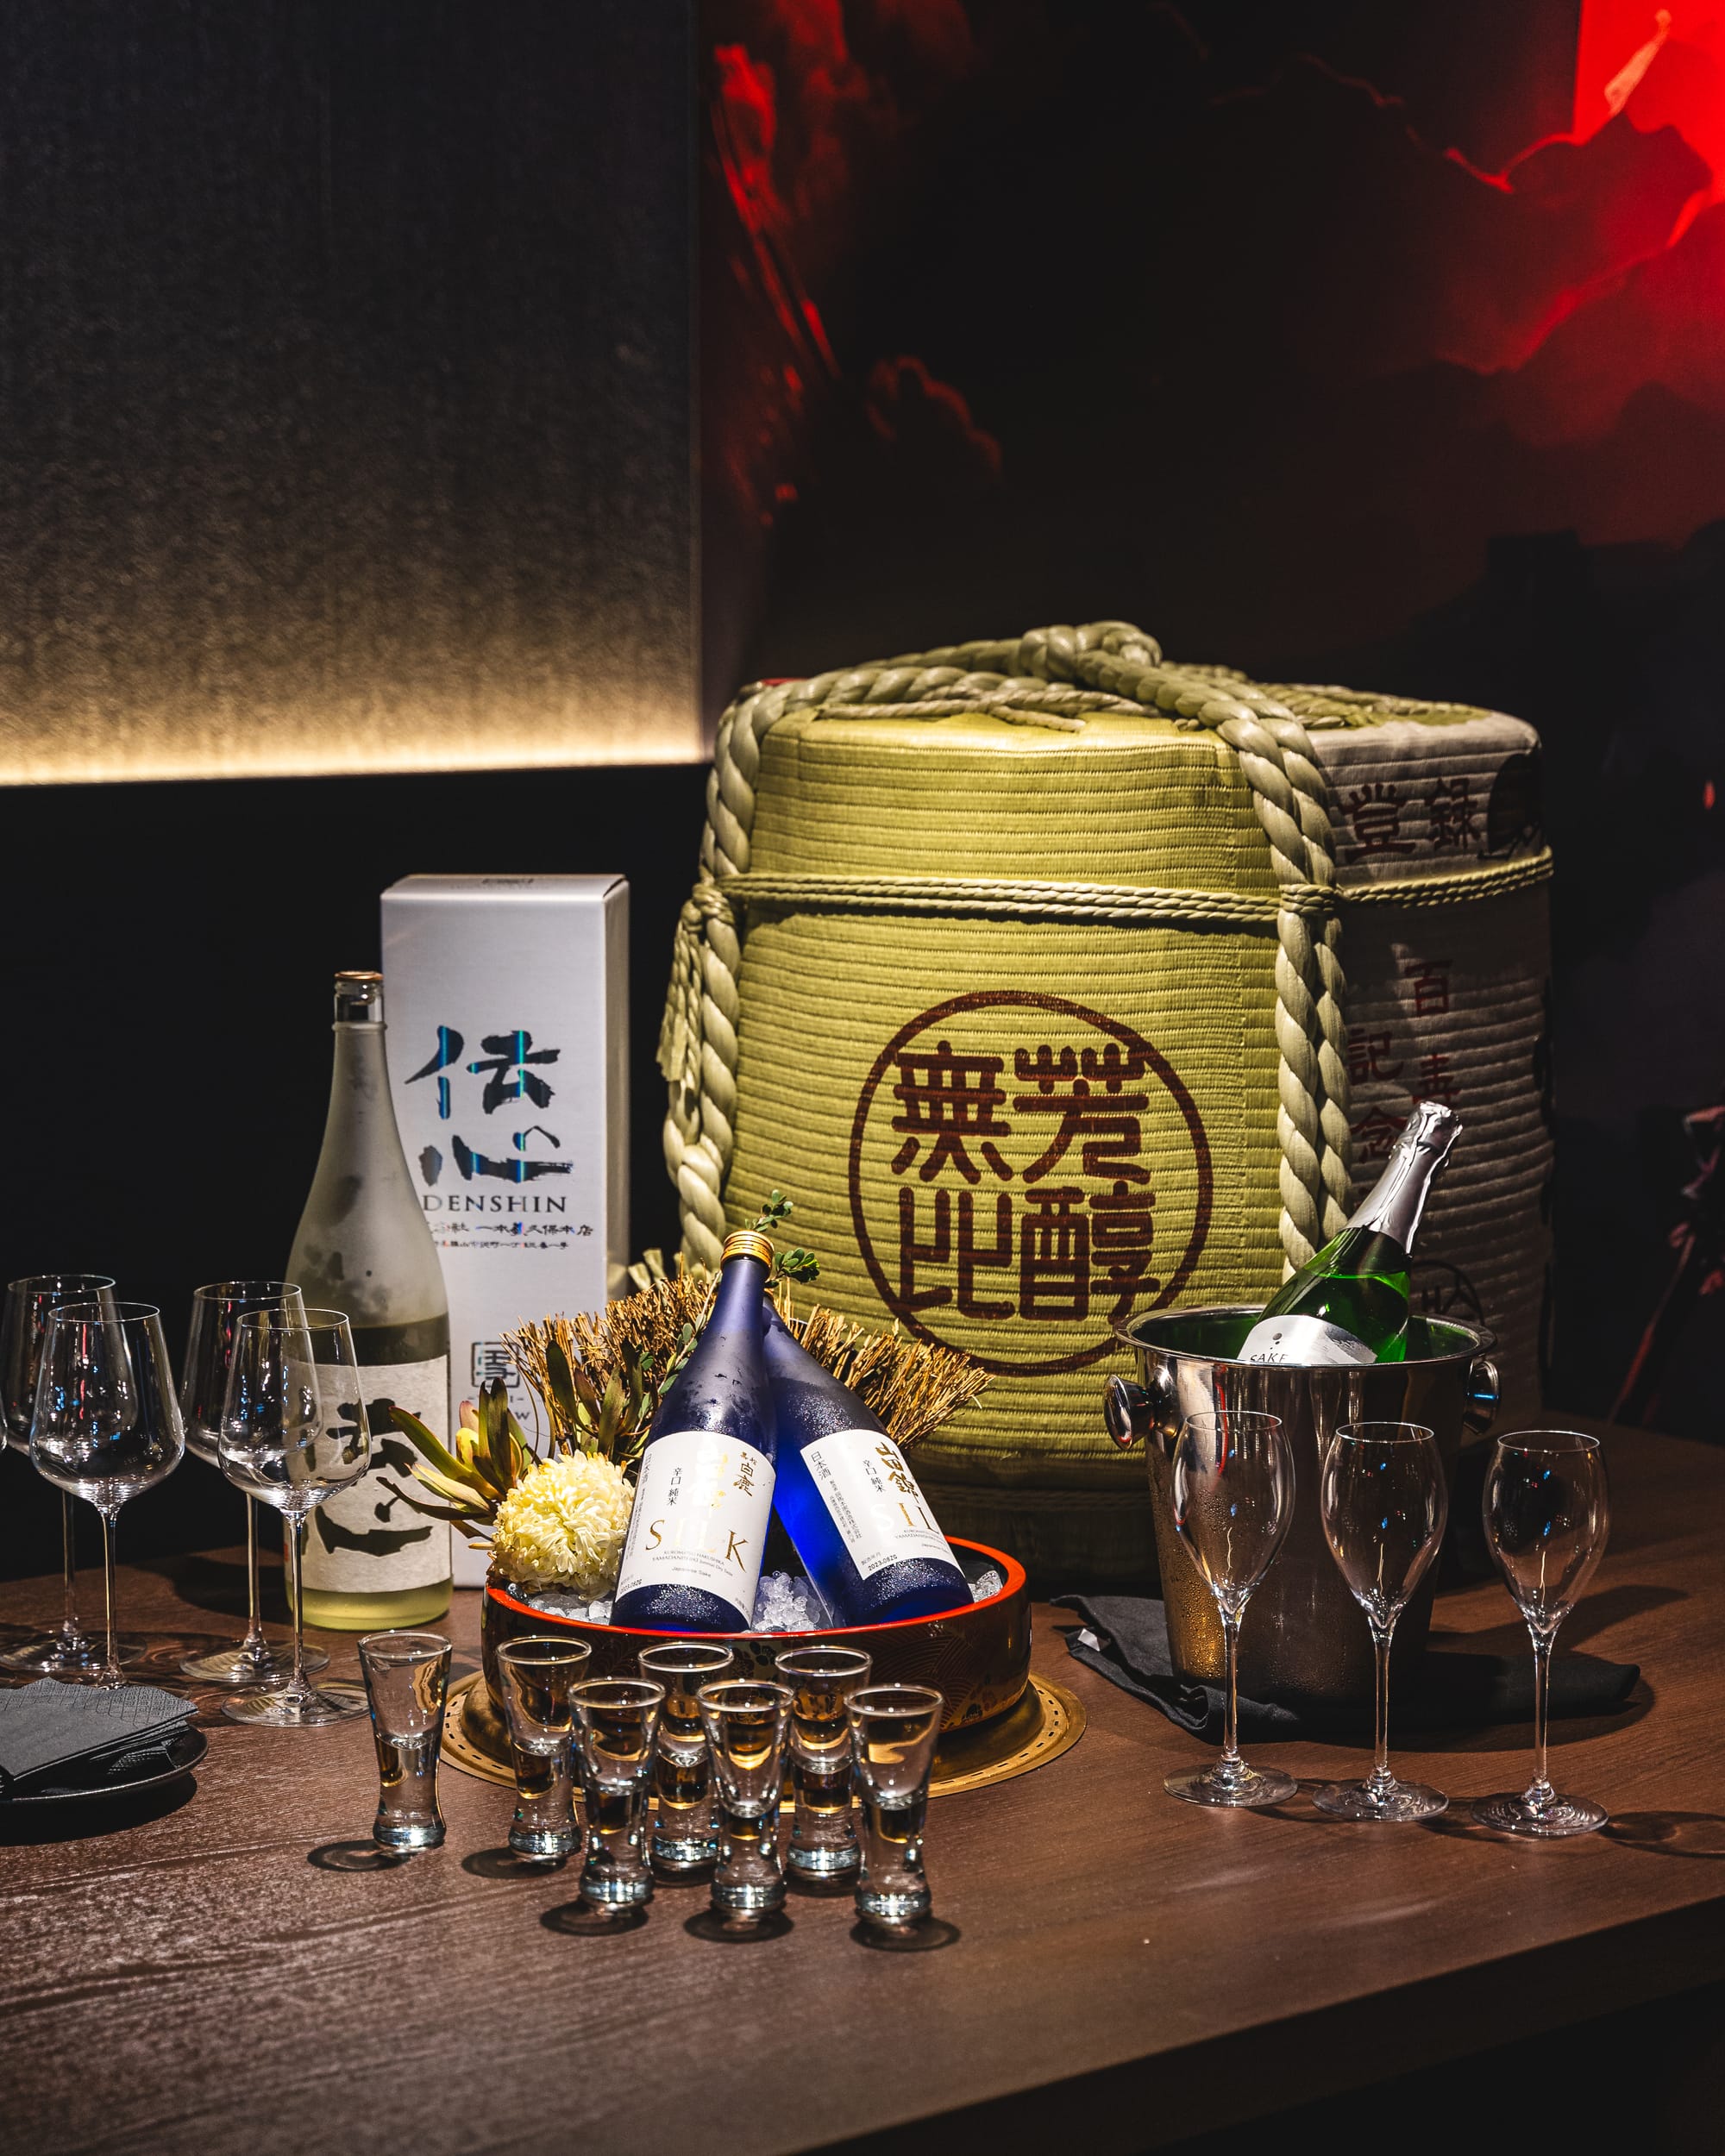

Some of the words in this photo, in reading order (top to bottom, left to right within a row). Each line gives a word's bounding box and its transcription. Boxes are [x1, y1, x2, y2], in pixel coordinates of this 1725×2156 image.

[423, 1194, 567, 1213] DENSHIN
[811, 1451, 831, 1481] 日本酒
